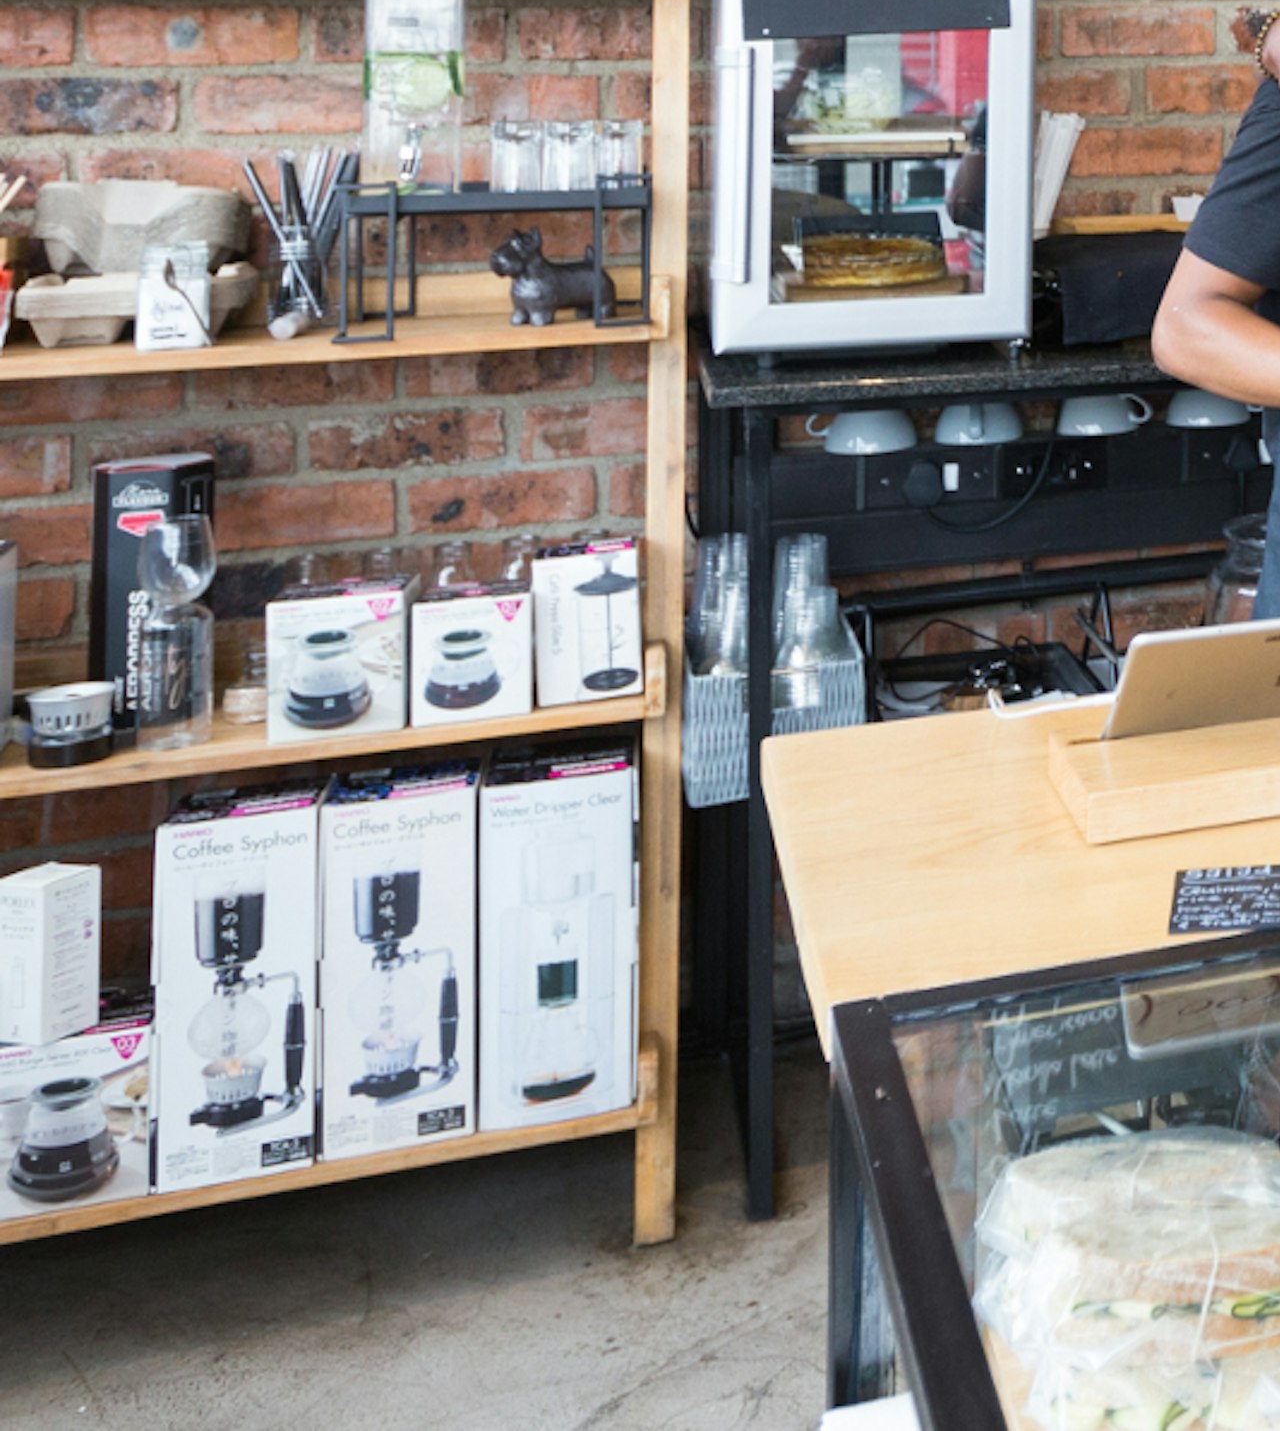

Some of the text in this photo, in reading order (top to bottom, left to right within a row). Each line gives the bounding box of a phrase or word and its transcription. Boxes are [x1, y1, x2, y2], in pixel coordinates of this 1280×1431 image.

[332, 819, 391, 840] Coffee
[397, 809, 463, 835] Syphon
[172, 838, 234, 861] Coffee
[240, 829, 309, 855] Syphon
